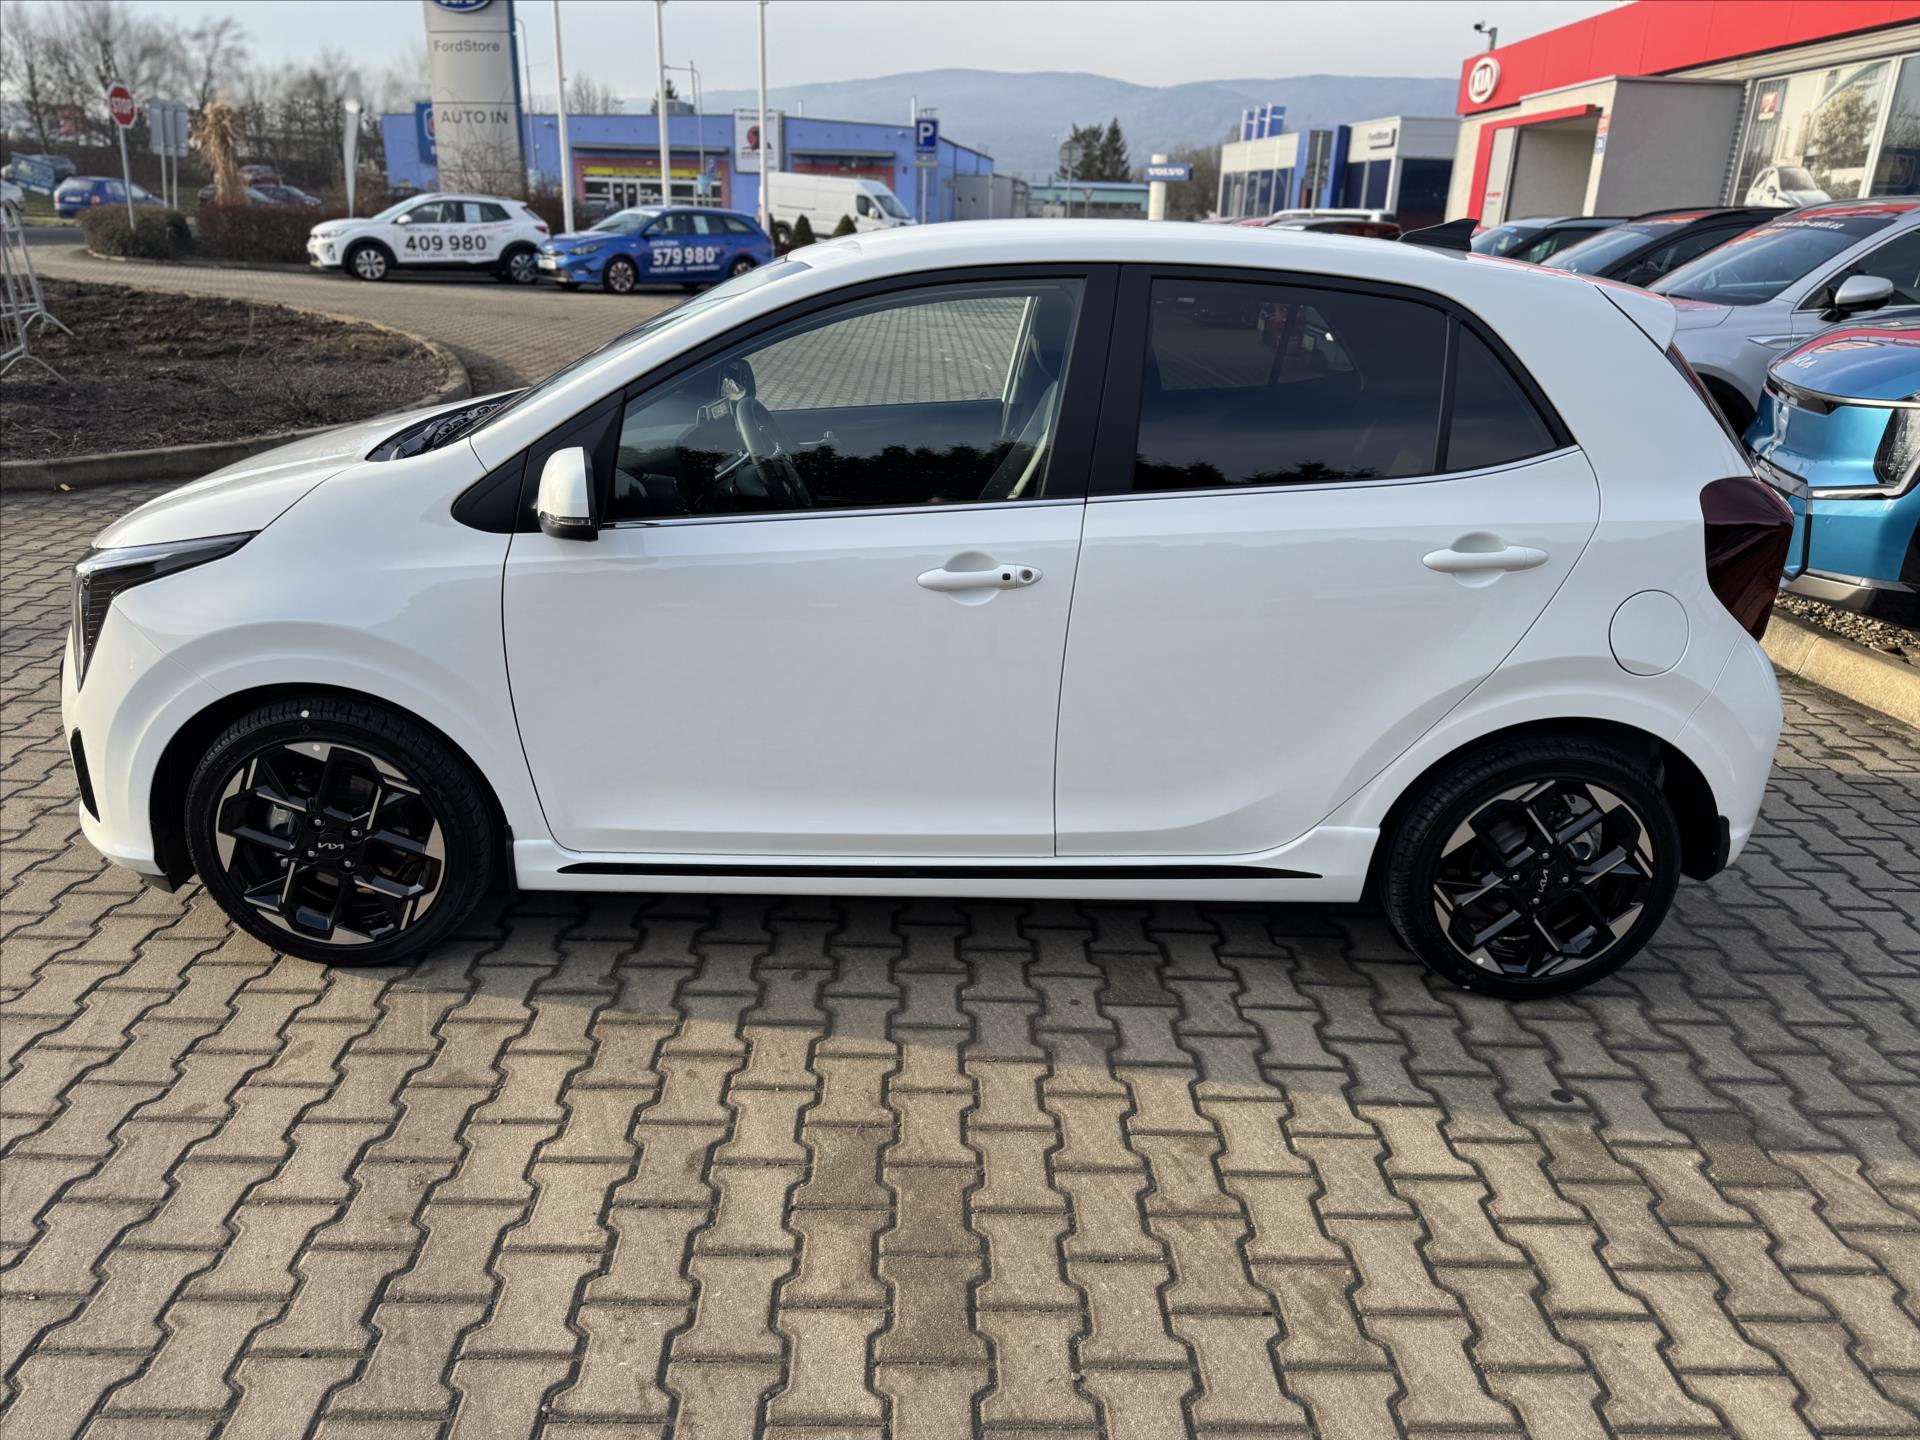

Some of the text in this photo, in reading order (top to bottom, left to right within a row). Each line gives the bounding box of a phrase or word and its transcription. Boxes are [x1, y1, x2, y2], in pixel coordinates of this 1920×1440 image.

[433, 40, 500, 52] FordStore
[111, 96, 132, 115] STOP
[441, 111, 509, 124] AUTO IN
[919, 123, 934, 144] P
[1148, 167, 1185, 176] VOLVO
[405, 235, 486, 251] 409 980
[653, 246, 715, 265] 579 980
